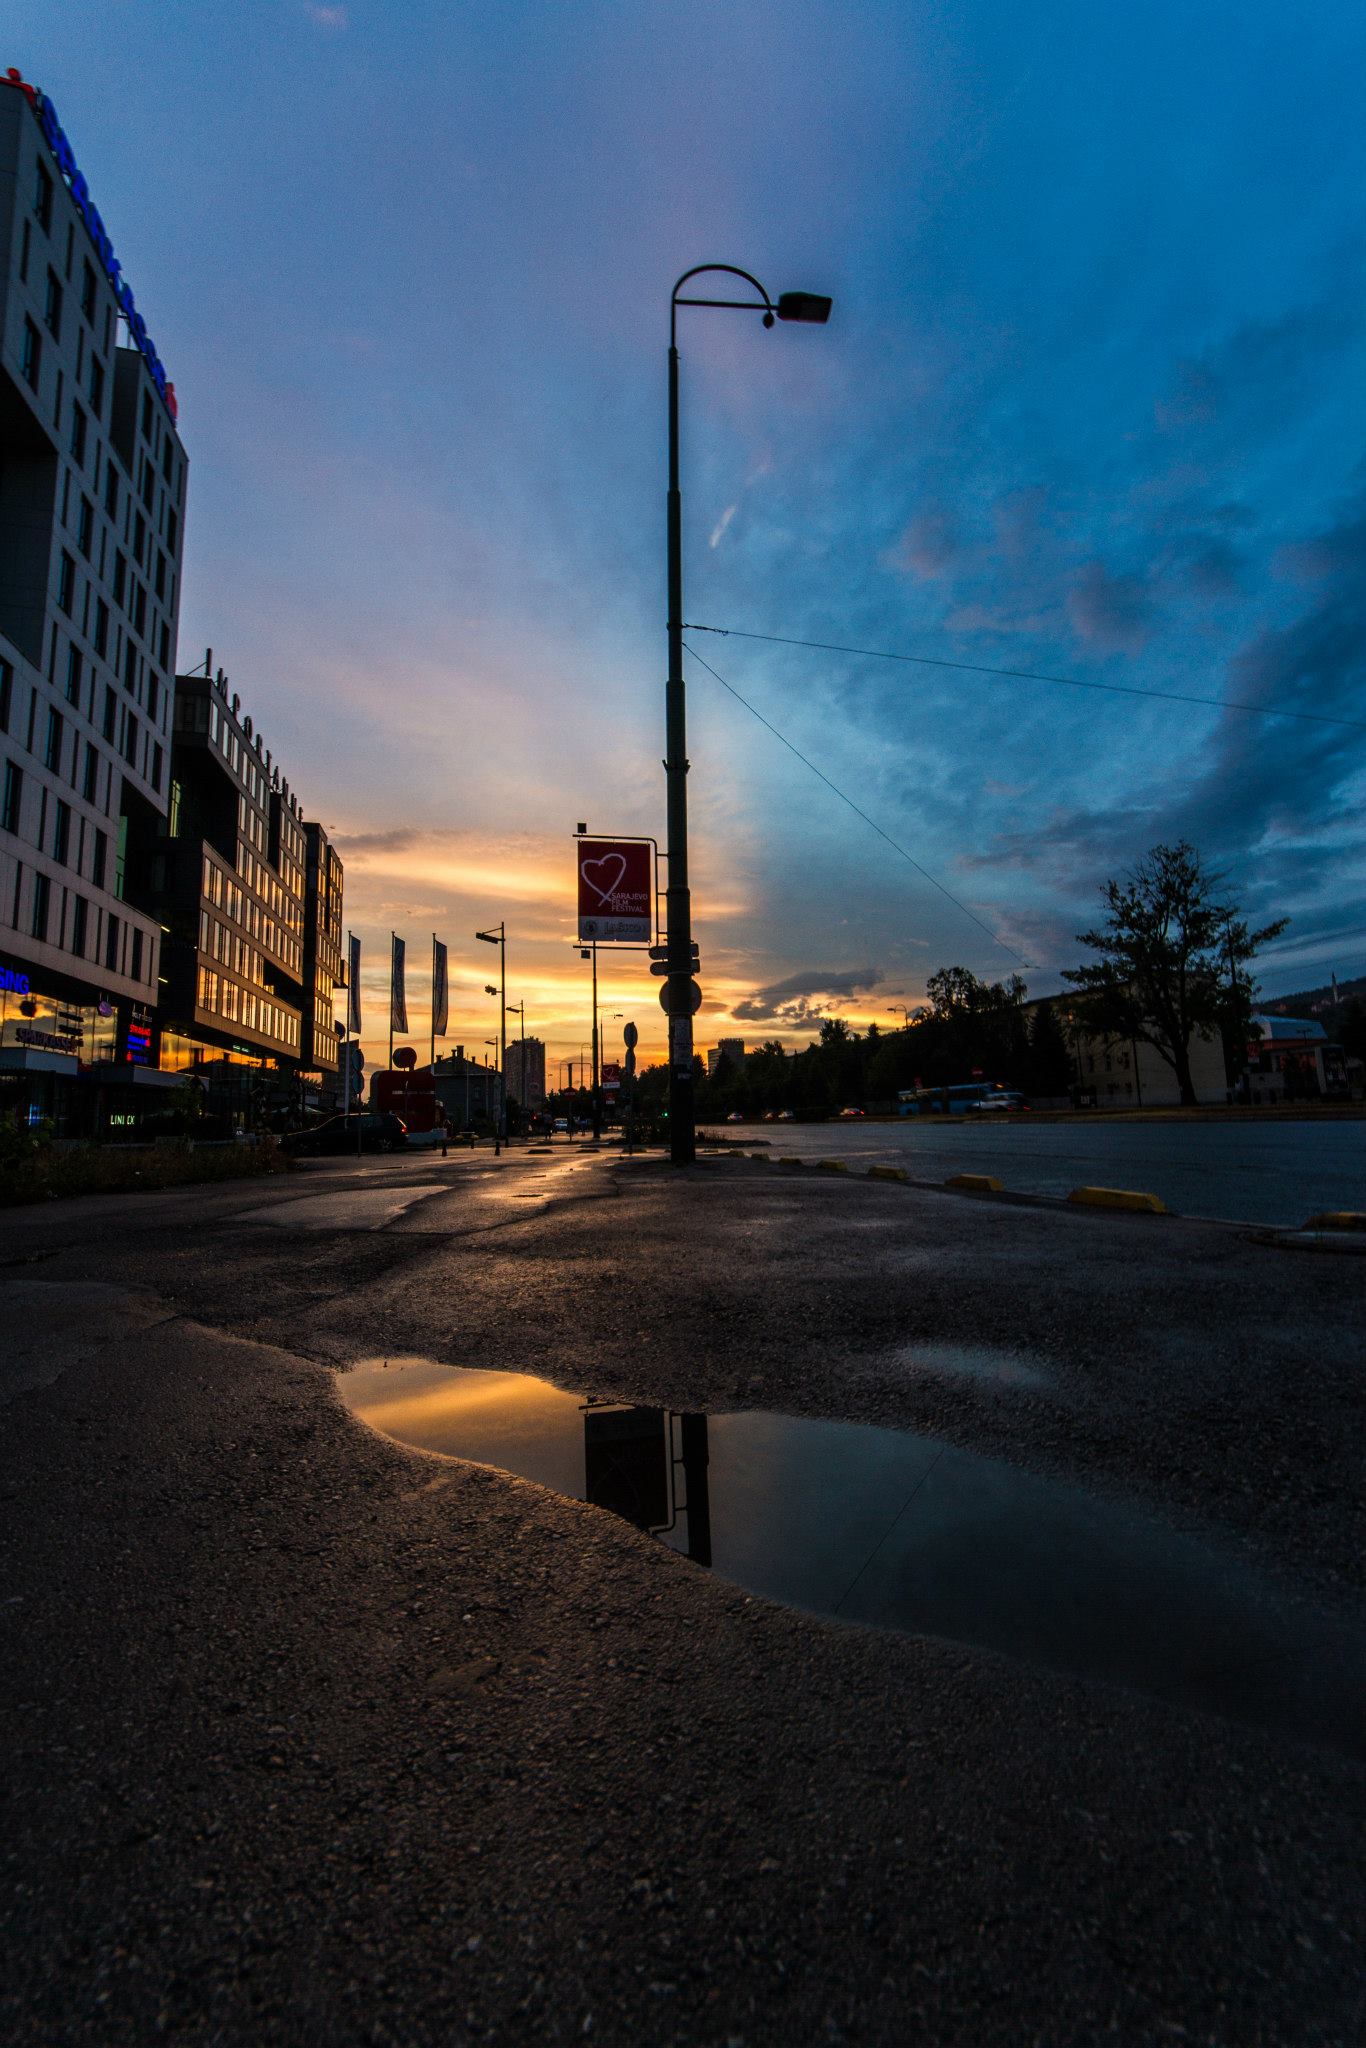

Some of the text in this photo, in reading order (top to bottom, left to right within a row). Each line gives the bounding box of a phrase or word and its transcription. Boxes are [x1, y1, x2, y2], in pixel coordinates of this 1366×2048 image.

[611, 892, 648, 900] SARAJEVO
[611, 904, 644, 912] FESTIVAL
[15, 1028, 73, 1050] SPARKASSE
